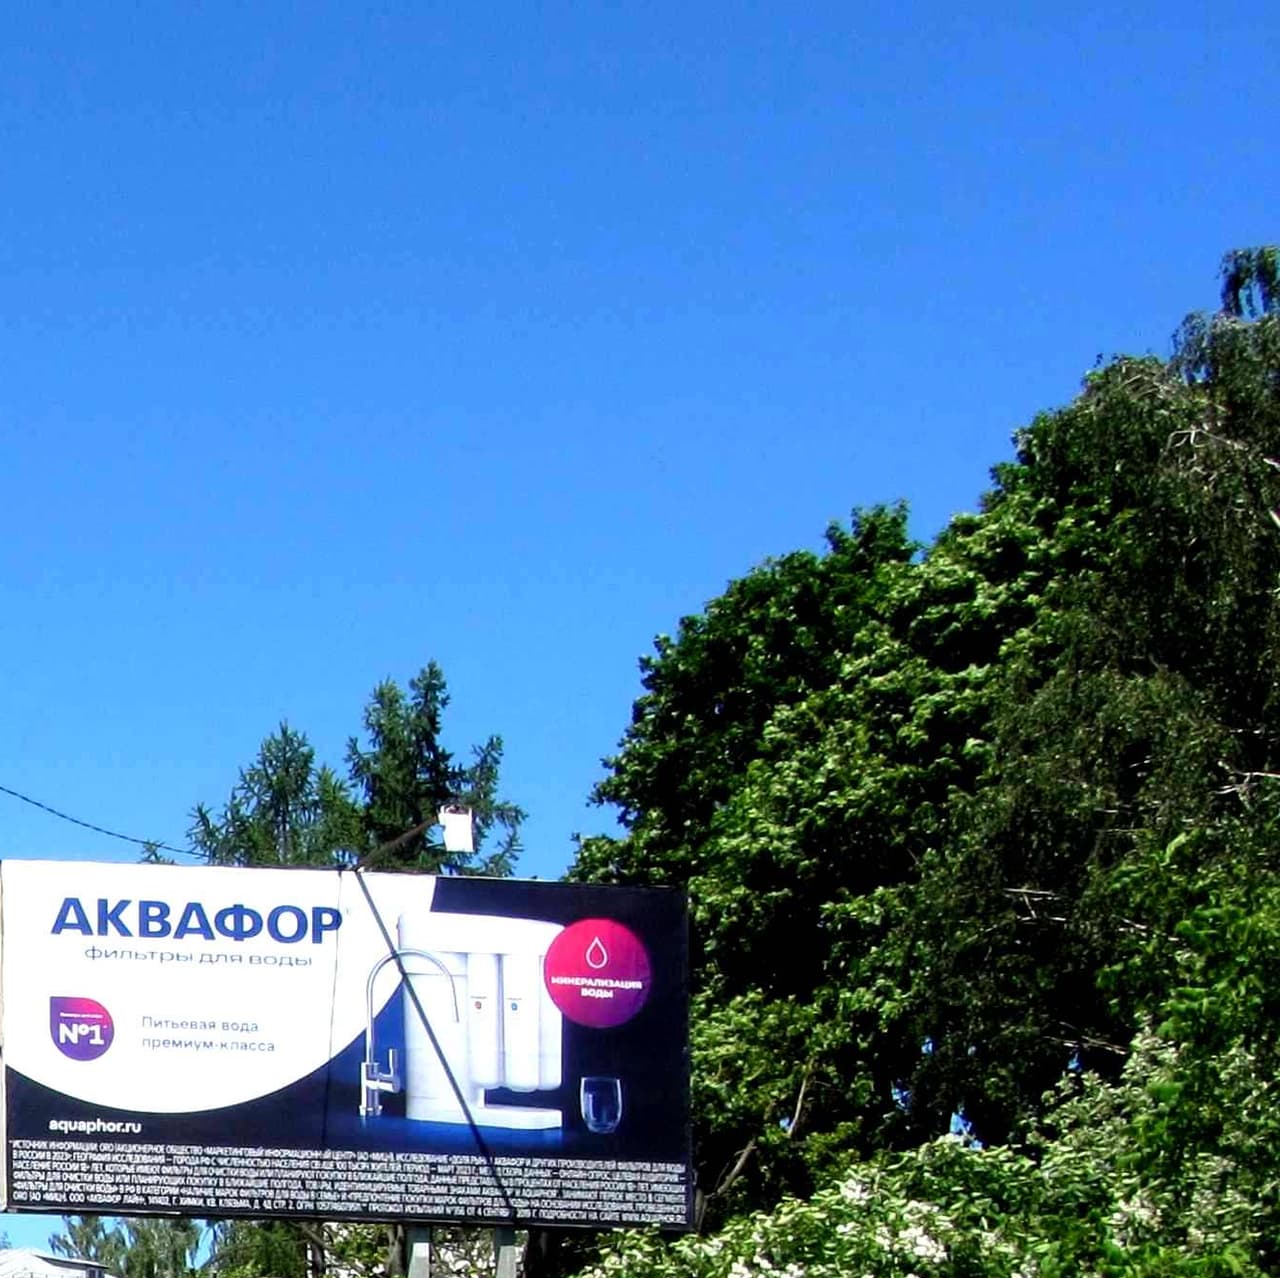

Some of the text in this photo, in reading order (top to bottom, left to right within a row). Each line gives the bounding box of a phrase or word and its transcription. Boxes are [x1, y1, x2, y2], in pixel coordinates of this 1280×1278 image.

[50, 897, 343, 944] АКВАФОР
[84, 945, 312, 967] фильтры для воды
[551, 976, 643, 990] МИНЕРАЛИЗАЦИЯ
[580, 987, 613, 999] ВОДЫ
[141, 1015, 259, 1033] Питьевая вода
[141, 1037, 276, 1052] премиум-класса
[48, 1117, 143, 1135] aquaphor.ru
